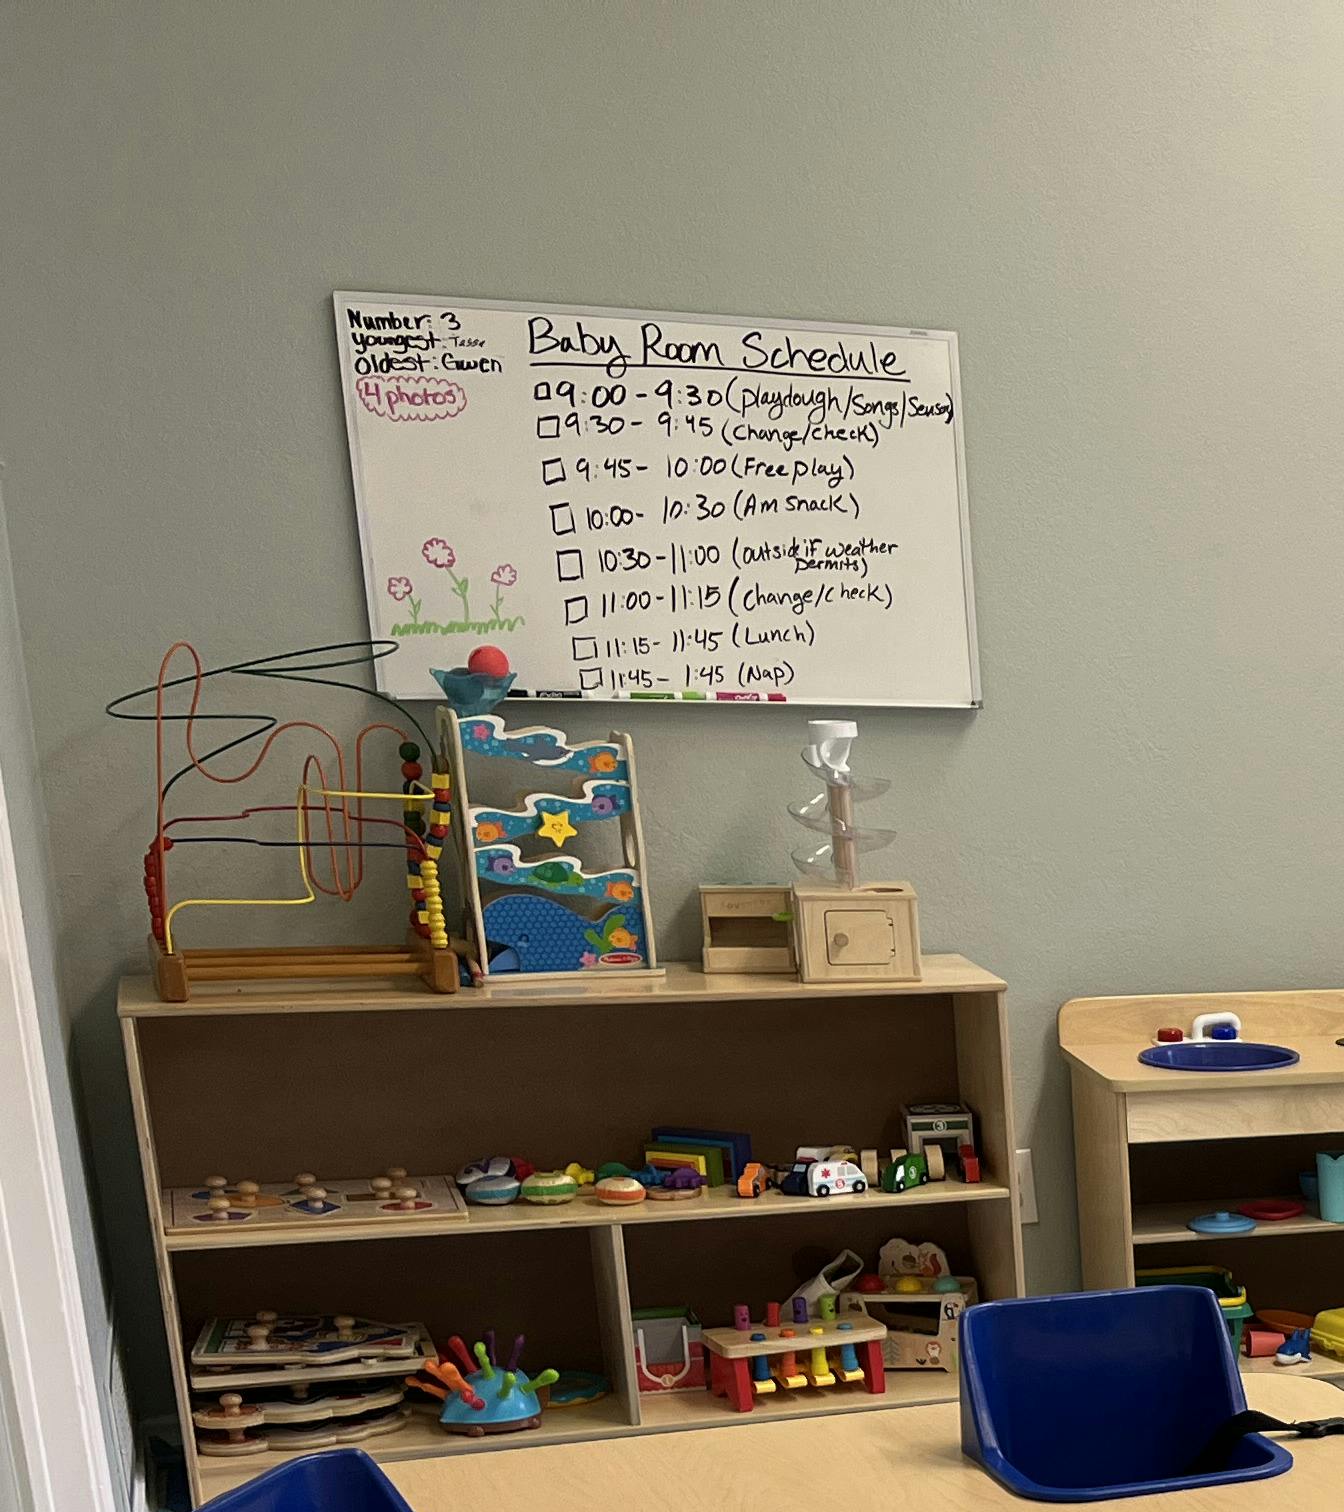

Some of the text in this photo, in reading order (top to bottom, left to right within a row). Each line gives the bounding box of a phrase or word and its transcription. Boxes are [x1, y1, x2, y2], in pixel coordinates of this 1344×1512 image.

[440, 311, 461, 330] 3
[528, 316, 906, 379] Baby Room Schedule
[441, 353, 502, 373] Gwen
[364, 382, 457, 415] 4 photos
[657, 411, 714, 438] 9:45
[825, 537, 899, 559] weather
[673, 628, 724, 652] 11:45
[686, 663, 724, 688] 1:45
[738, 660, 795, 687] (Nap)
